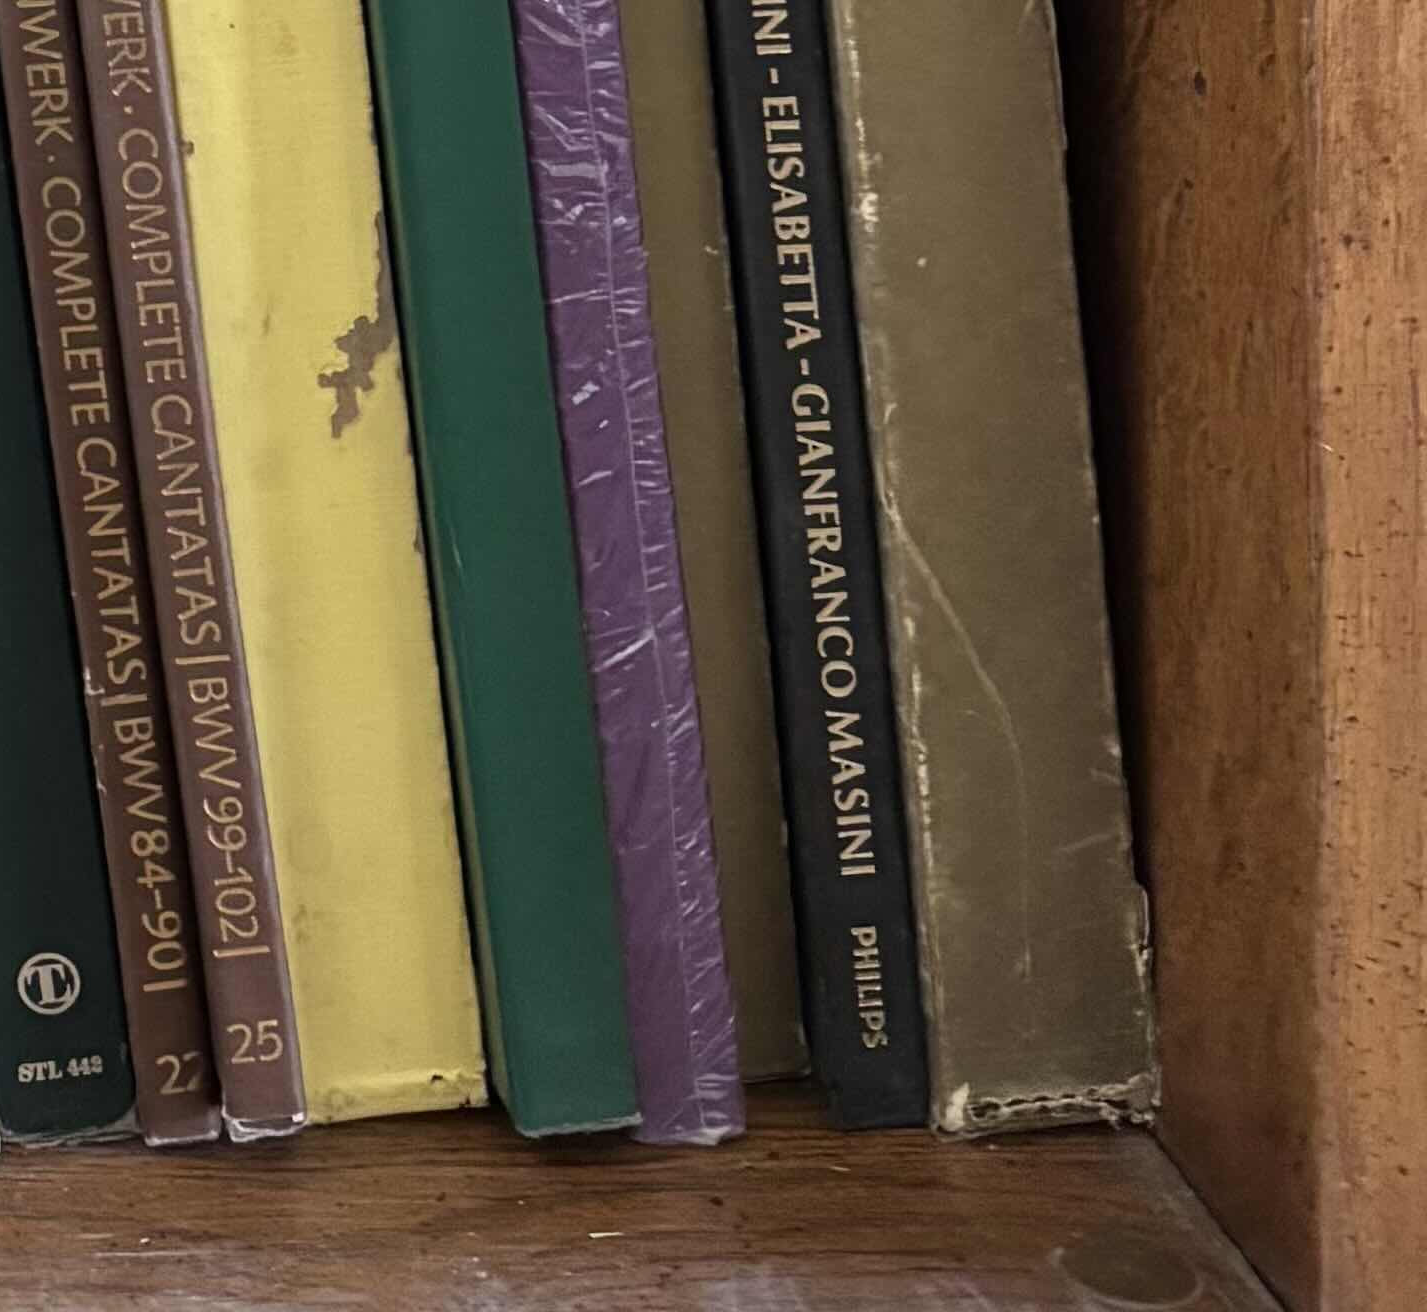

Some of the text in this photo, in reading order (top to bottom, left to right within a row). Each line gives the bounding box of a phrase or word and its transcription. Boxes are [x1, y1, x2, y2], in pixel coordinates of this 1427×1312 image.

[42, 177, 111, 426] COMPLETE
[118, 128, 187, 383] COMPLETE
[762, 95, 822, 351] ELISABETTA
[76, 437, 147, 685] CANTATAS
[150, 394, 221, 646] CANTATAS
[791, 383, 858, 698] GIANFRANCO
[113, 716, 168, 822] BWV
[187, 675, 242, 790] BWV
[823, 709, 876, 877] MASINI
[203, 796, 259, 943] 99-102
[226, 1019, 284, 1064] 25
[851, 925, 888, 1050] PHILIPS
[18, 1061, 63, 1083] STL
